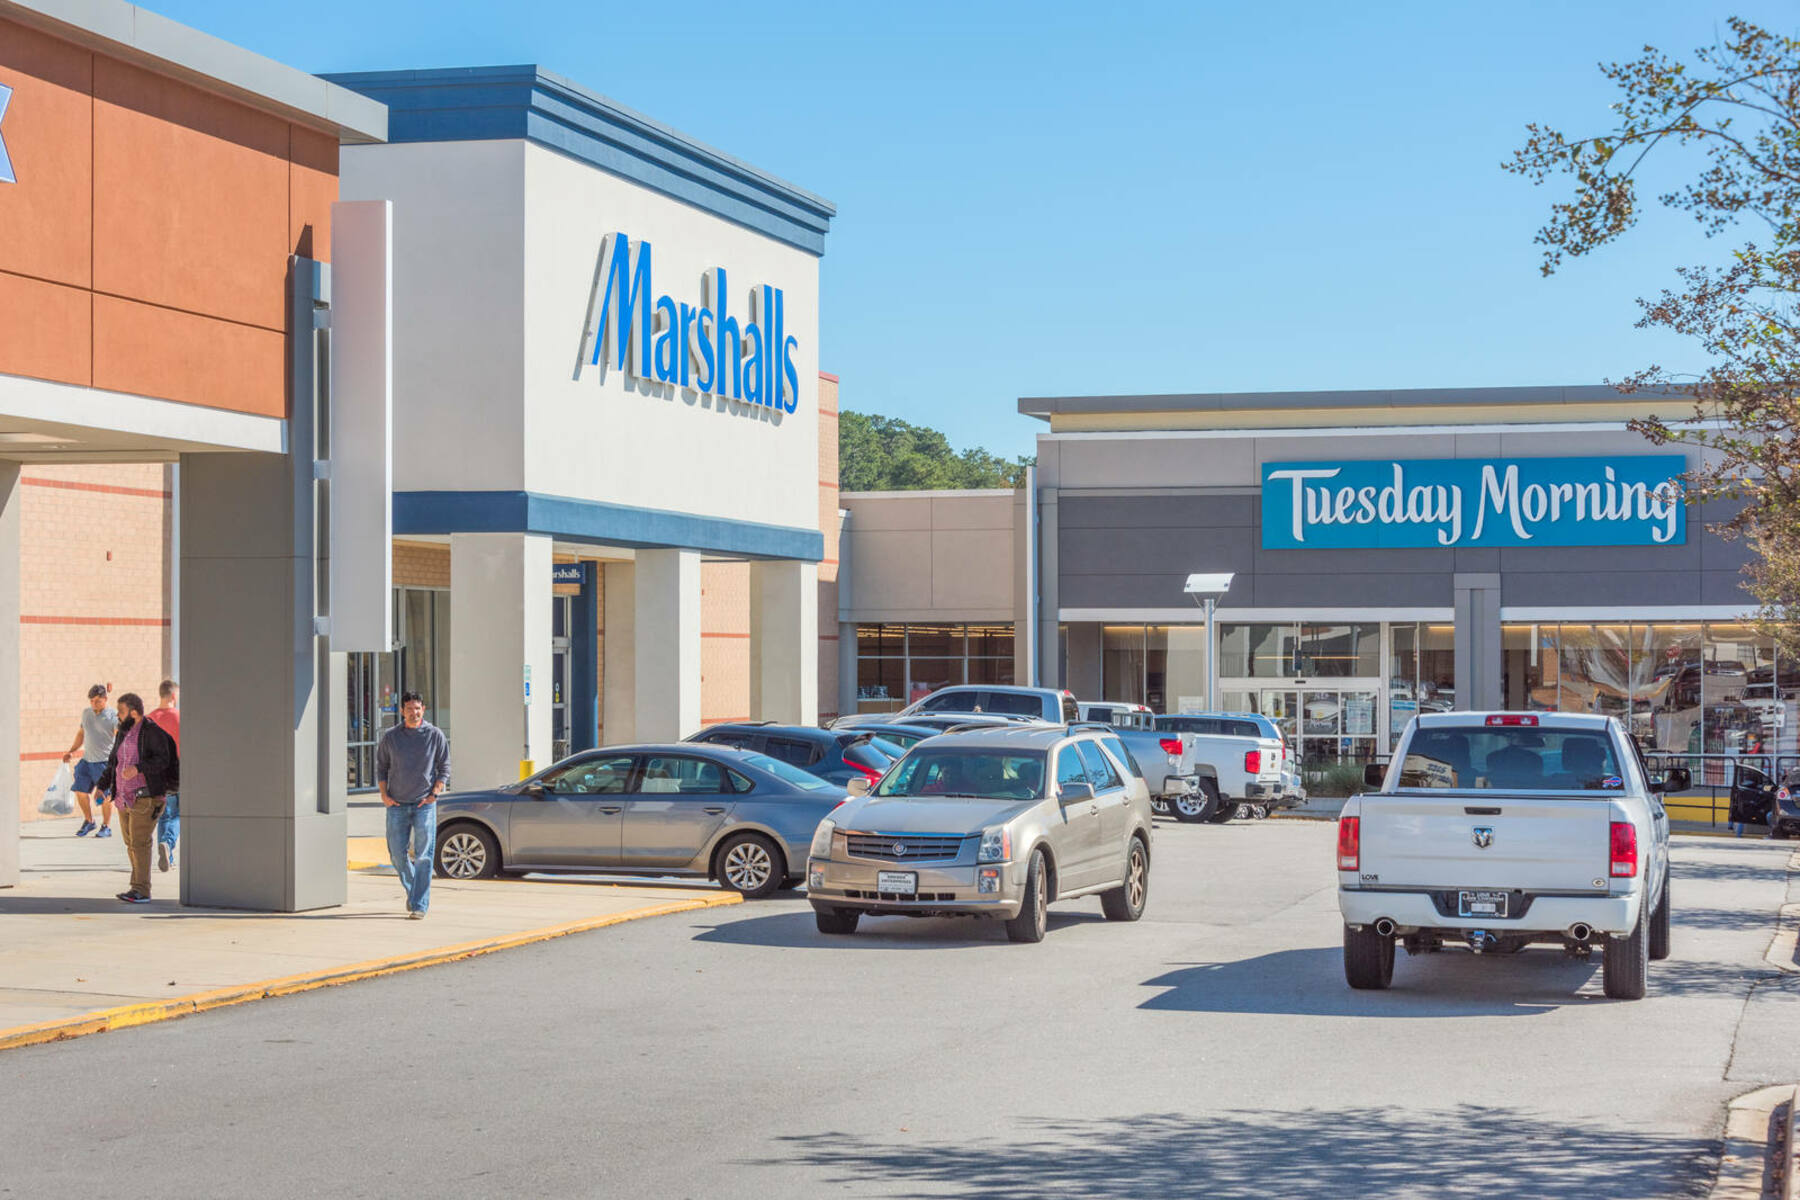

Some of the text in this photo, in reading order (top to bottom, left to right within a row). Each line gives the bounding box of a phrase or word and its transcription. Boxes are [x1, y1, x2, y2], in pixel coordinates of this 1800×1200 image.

[592, 232, 799, 414] Marshalls
[1267, 463, 1677, 545] Tuesday Morning
